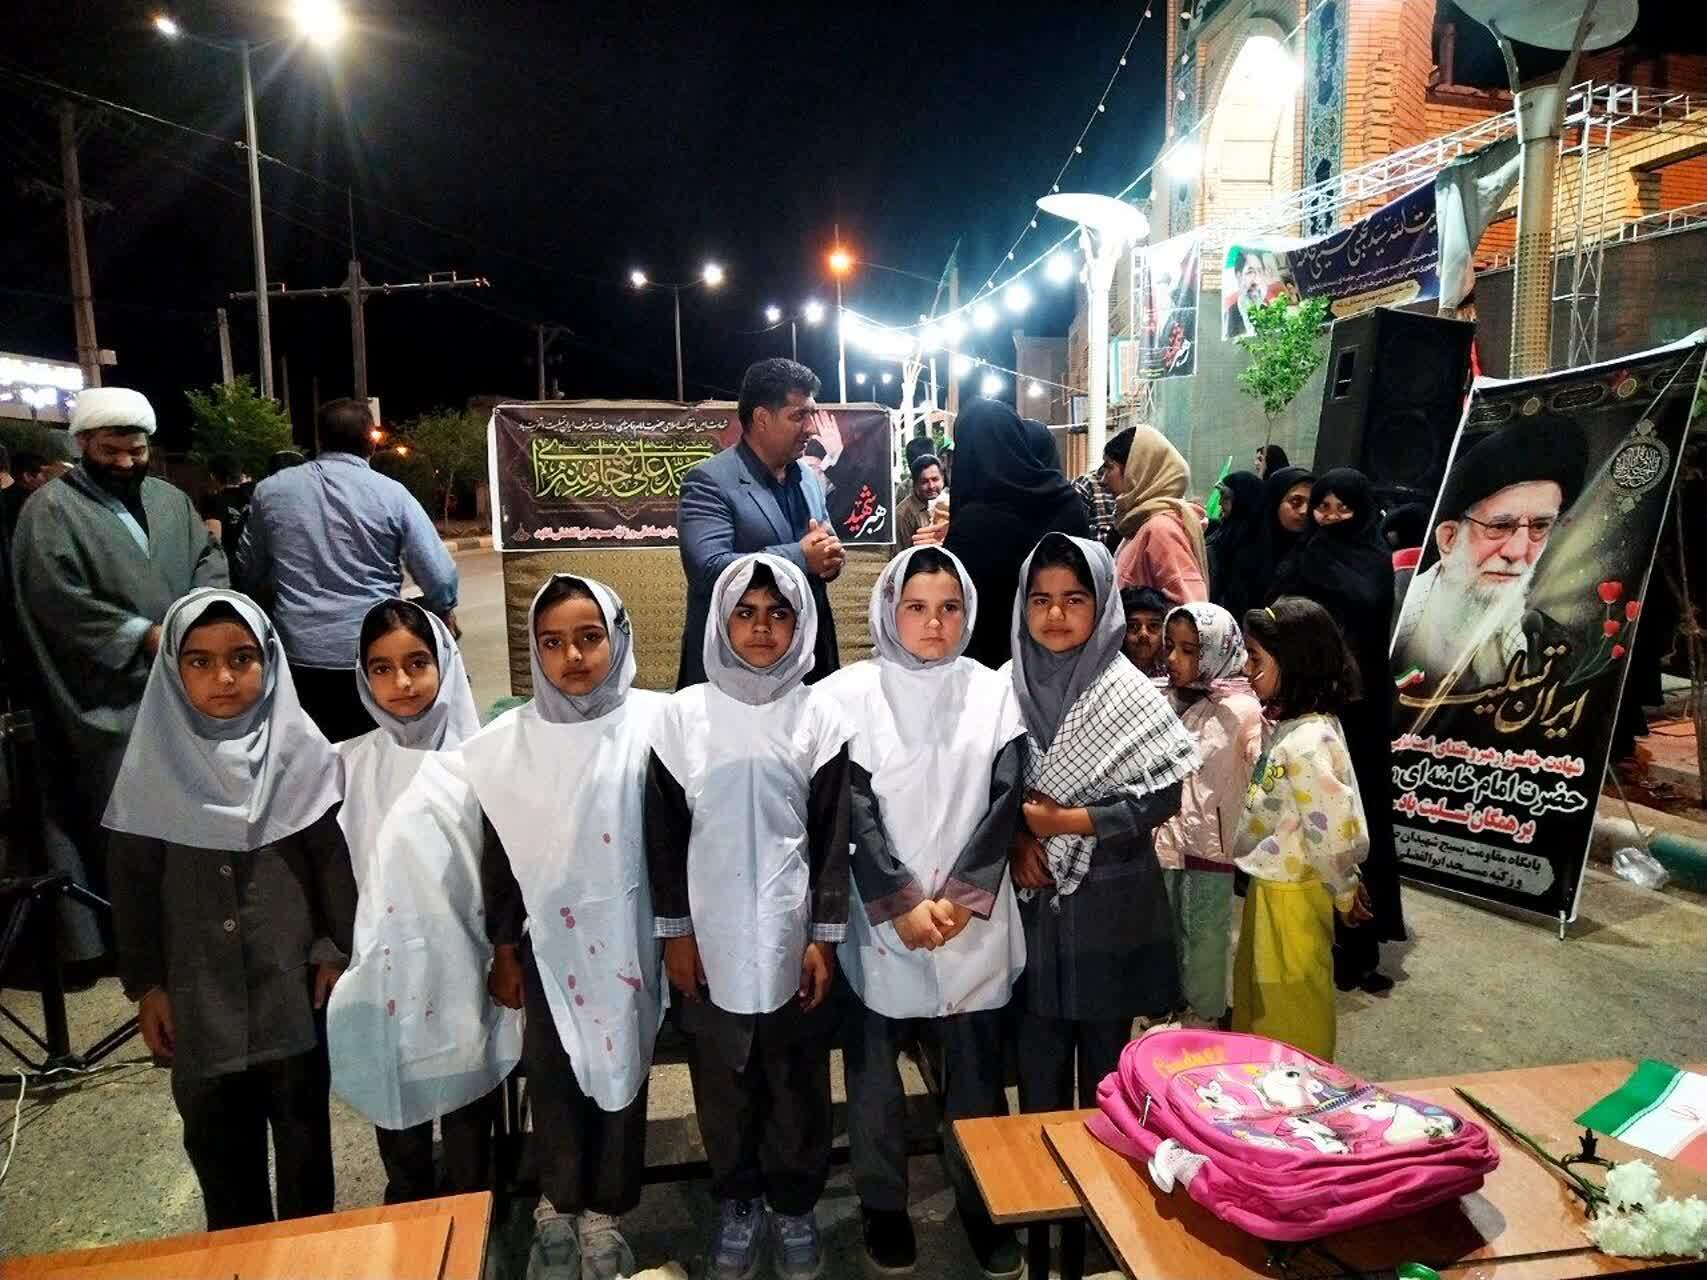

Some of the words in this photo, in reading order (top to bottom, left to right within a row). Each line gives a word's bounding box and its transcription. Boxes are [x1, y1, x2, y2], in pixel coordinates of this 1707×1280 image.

[1493, 680, 1591, 740] ایران
[1541, 755, 1586, 778] شهادت
[1472, 770, 1520, 804] امام
[1516, 780, 1588, 816] حضرت
[1415, 797, 1475, 825] تسلیت
[1468, 806, 1520, 834] همگان
[1400, 831, 1440, 848] شهیدان
[1512, 819, 1537, 844] بر
[1446, 859, 1489, 878] مسجد
[1466, 847, 1507, 865] مقاومت
[1508, 852, 1542, 876] پایگاه
